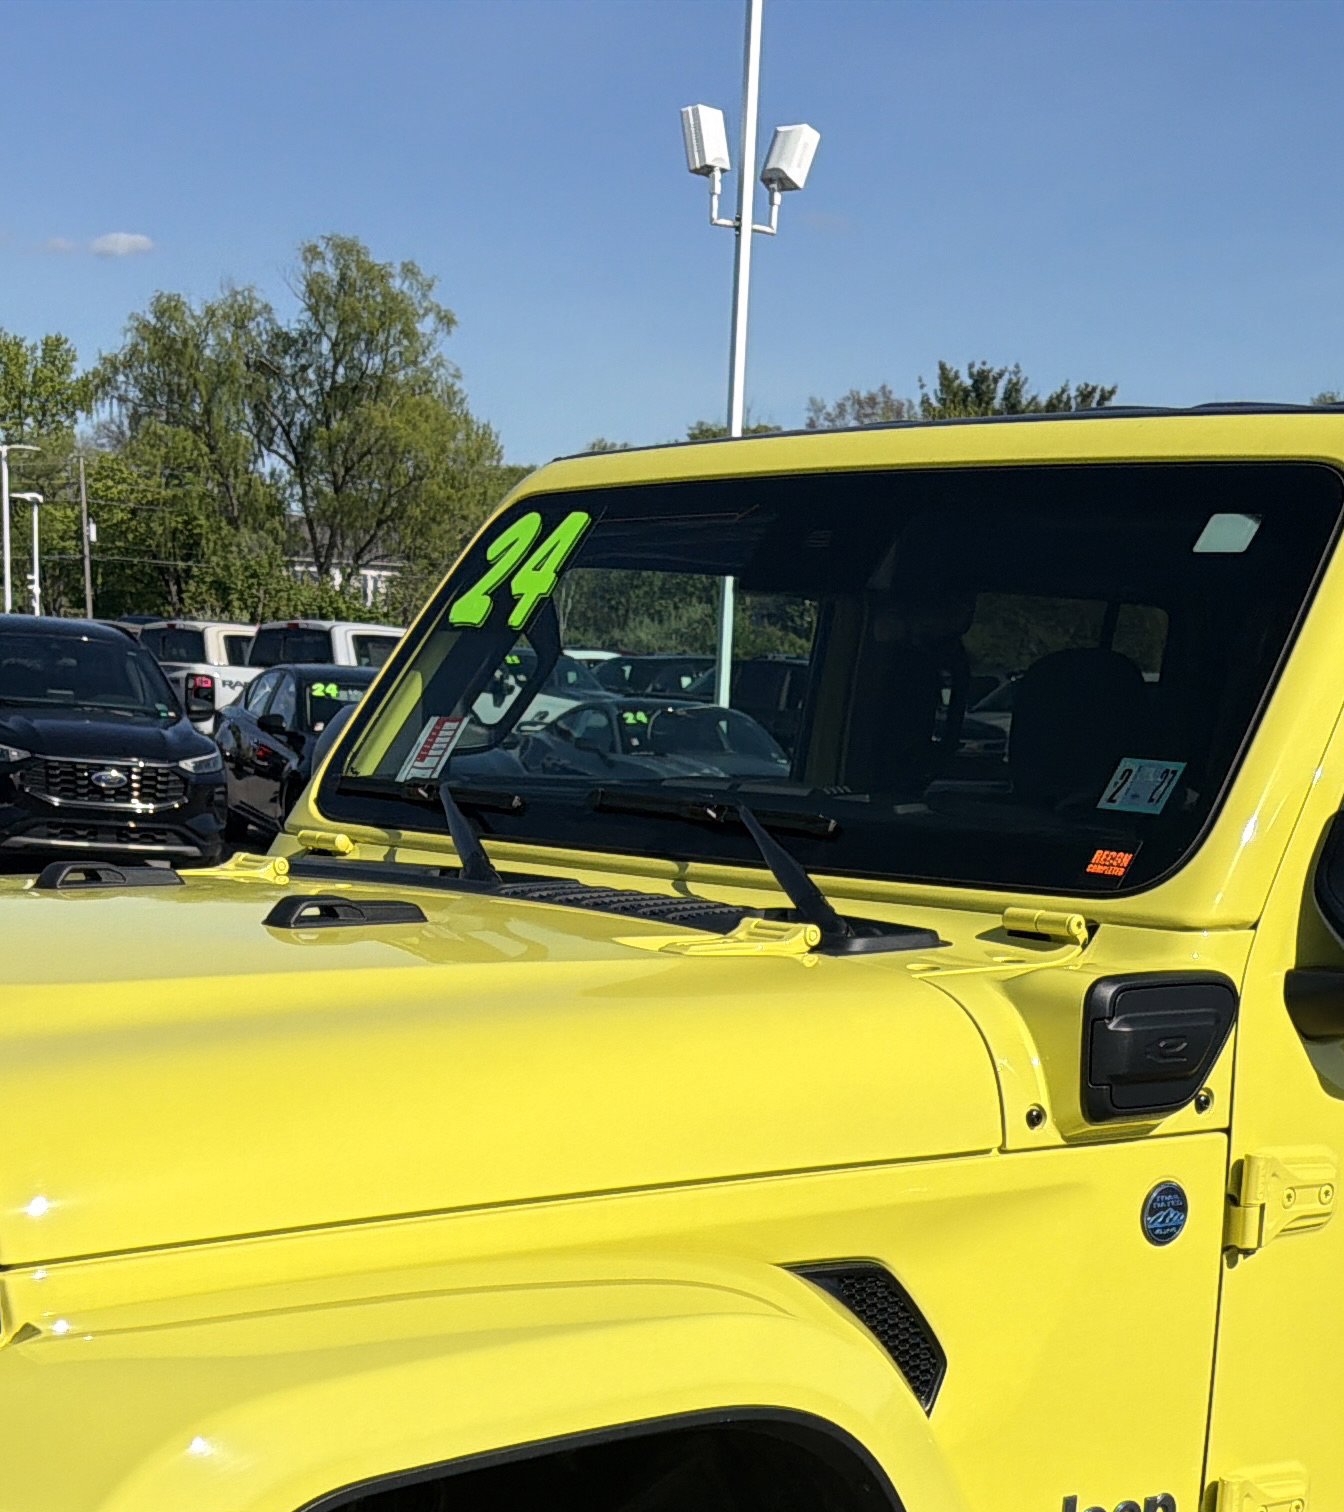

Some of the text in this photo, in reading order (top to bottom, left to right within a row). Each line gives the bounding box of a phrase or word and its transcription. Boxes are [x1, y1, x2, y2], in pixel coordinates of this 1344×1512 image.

[449, 511, 591, 630] 24
[311, 682, 338, 698] 24
[1106, 768, 1133, 804] 2
